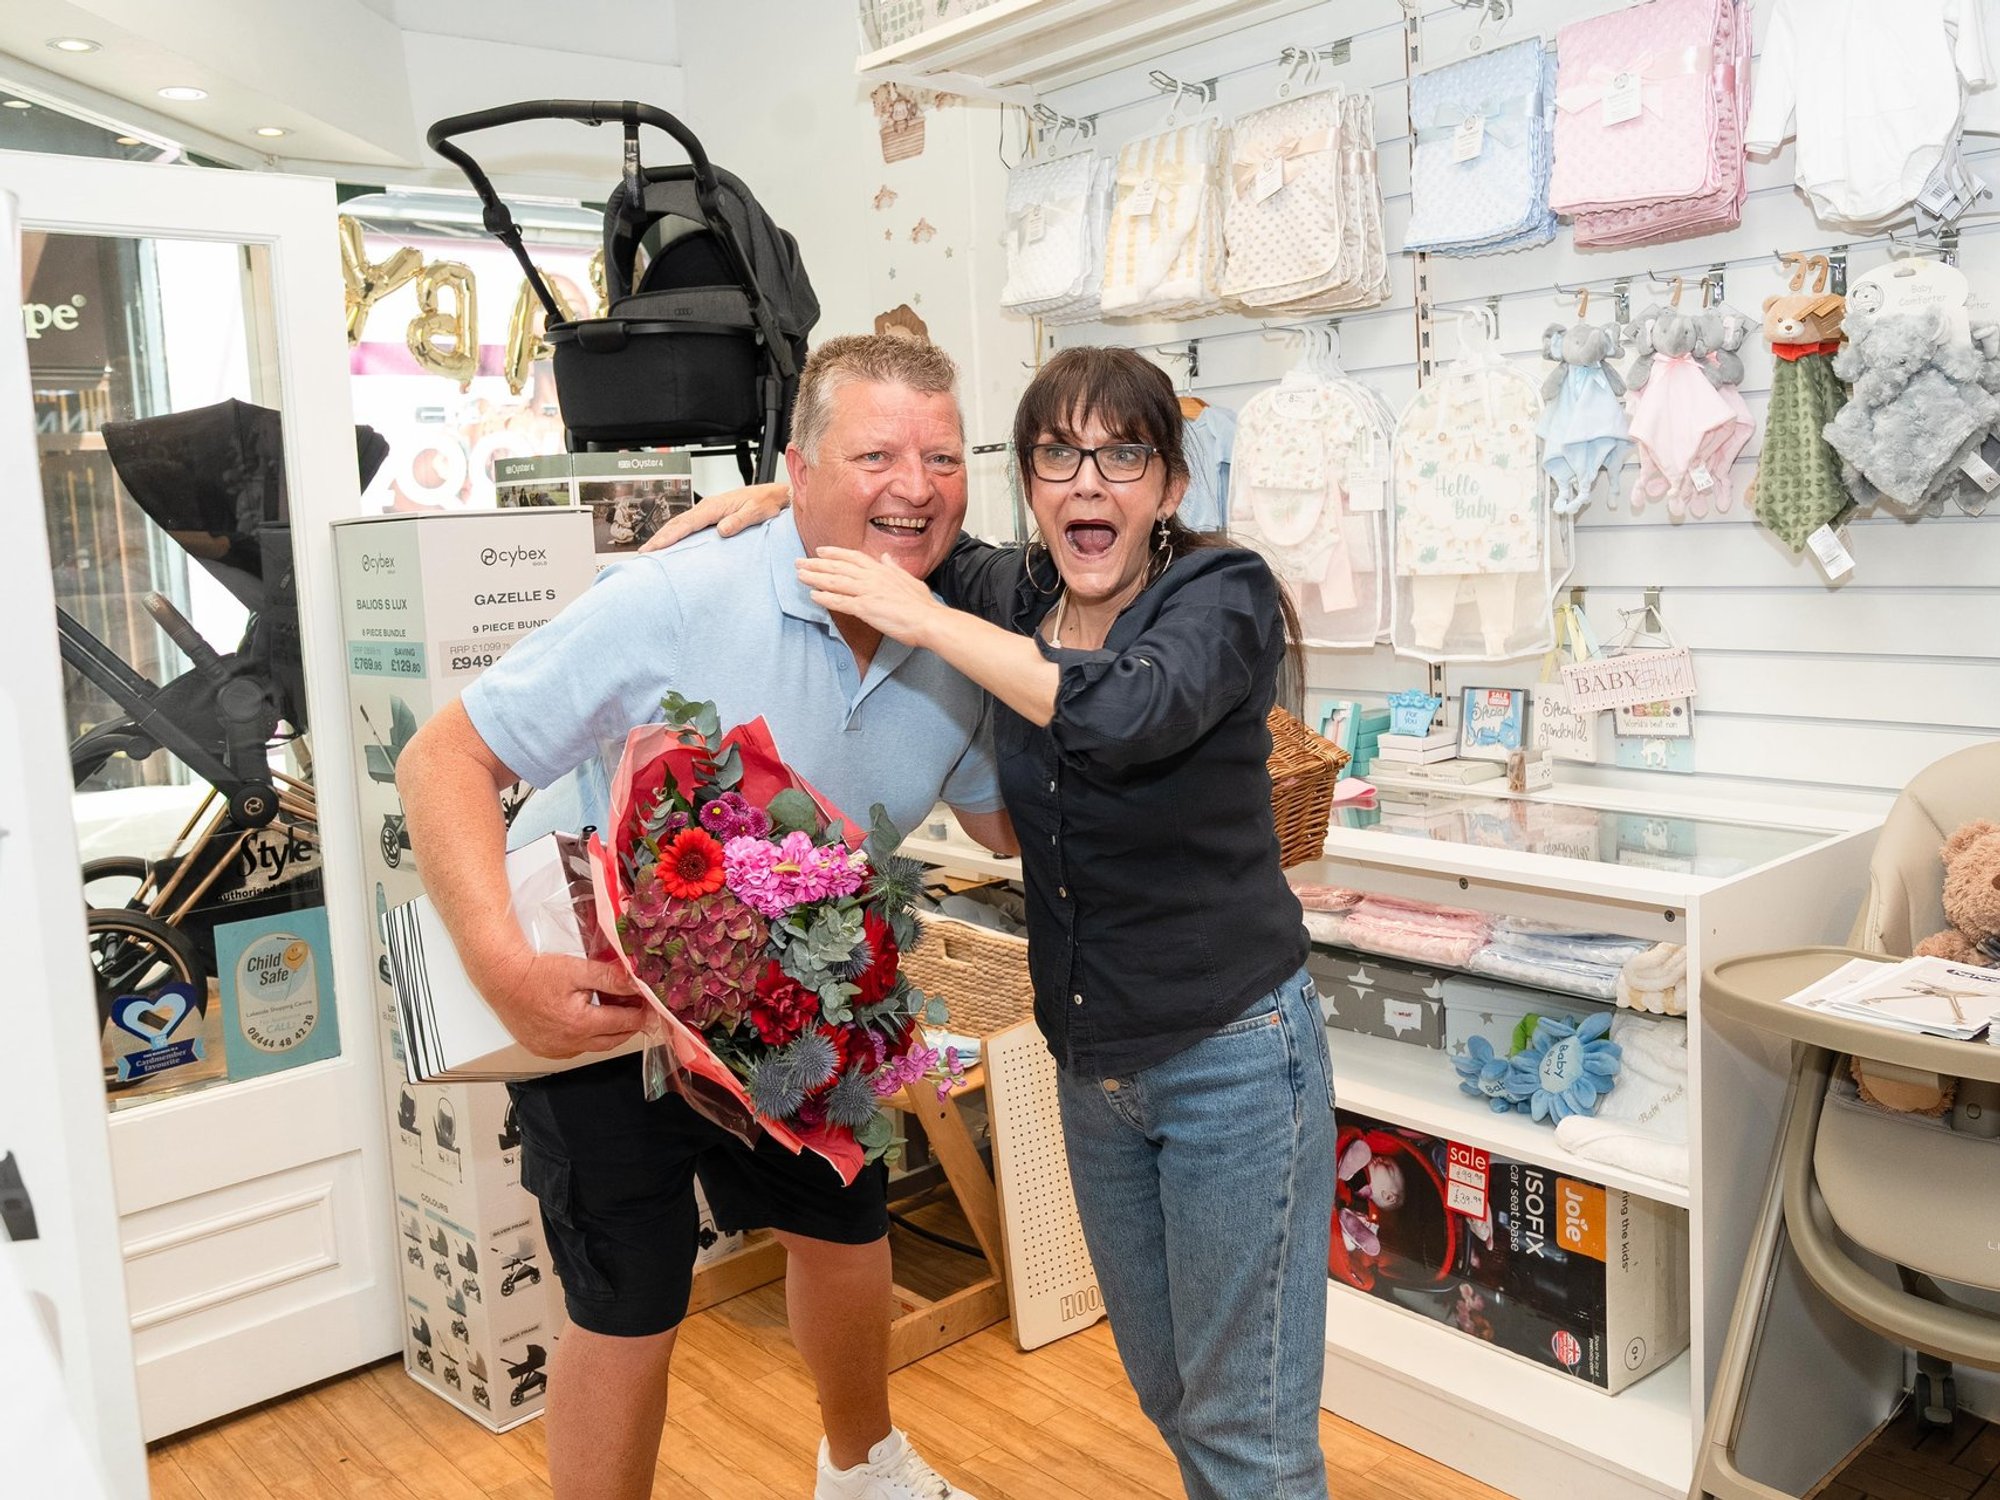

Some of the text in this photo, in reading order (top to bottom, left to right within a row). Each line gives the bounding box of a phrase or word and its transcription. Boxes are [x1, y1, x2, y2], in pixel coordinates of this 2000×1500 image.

[1435, 473, 1480, 498] Hello
[1454, 496, 1497, 524] Baby
[371, 553, 395, 575] cybex
[499, 545, 547, 567] cybex
[356, 599, 408, 610] BALIOS S LUX
[474, 589, 556, 606] GAZELLE S
[383, 628, 406, 637] BUNDLE
[472, 619, 552, 633] 9 PIECE BUND
[1574, 669, 1639, 695] BABY
[237, 826, 313, 882] Style
[247, 952, 282, 973] Child
[260, 968, 289, 986] Safe
[279, 1037, 293, 1048] 48
[295, 1028, 307, 1040] 42
[1554, 1043, 1569, 1079] Baby
[1449, 1146, 1486, 1170] sale
[1510, 1164, 1521, 1252] car seat base
[1525, 1170, 1545, 1258] ISOFIX
[1565, 1187, 1588, 1243] Joie
[1621, 1217, 1631, 1240] the
[1060, 1284, 1106, 1322] HOO
